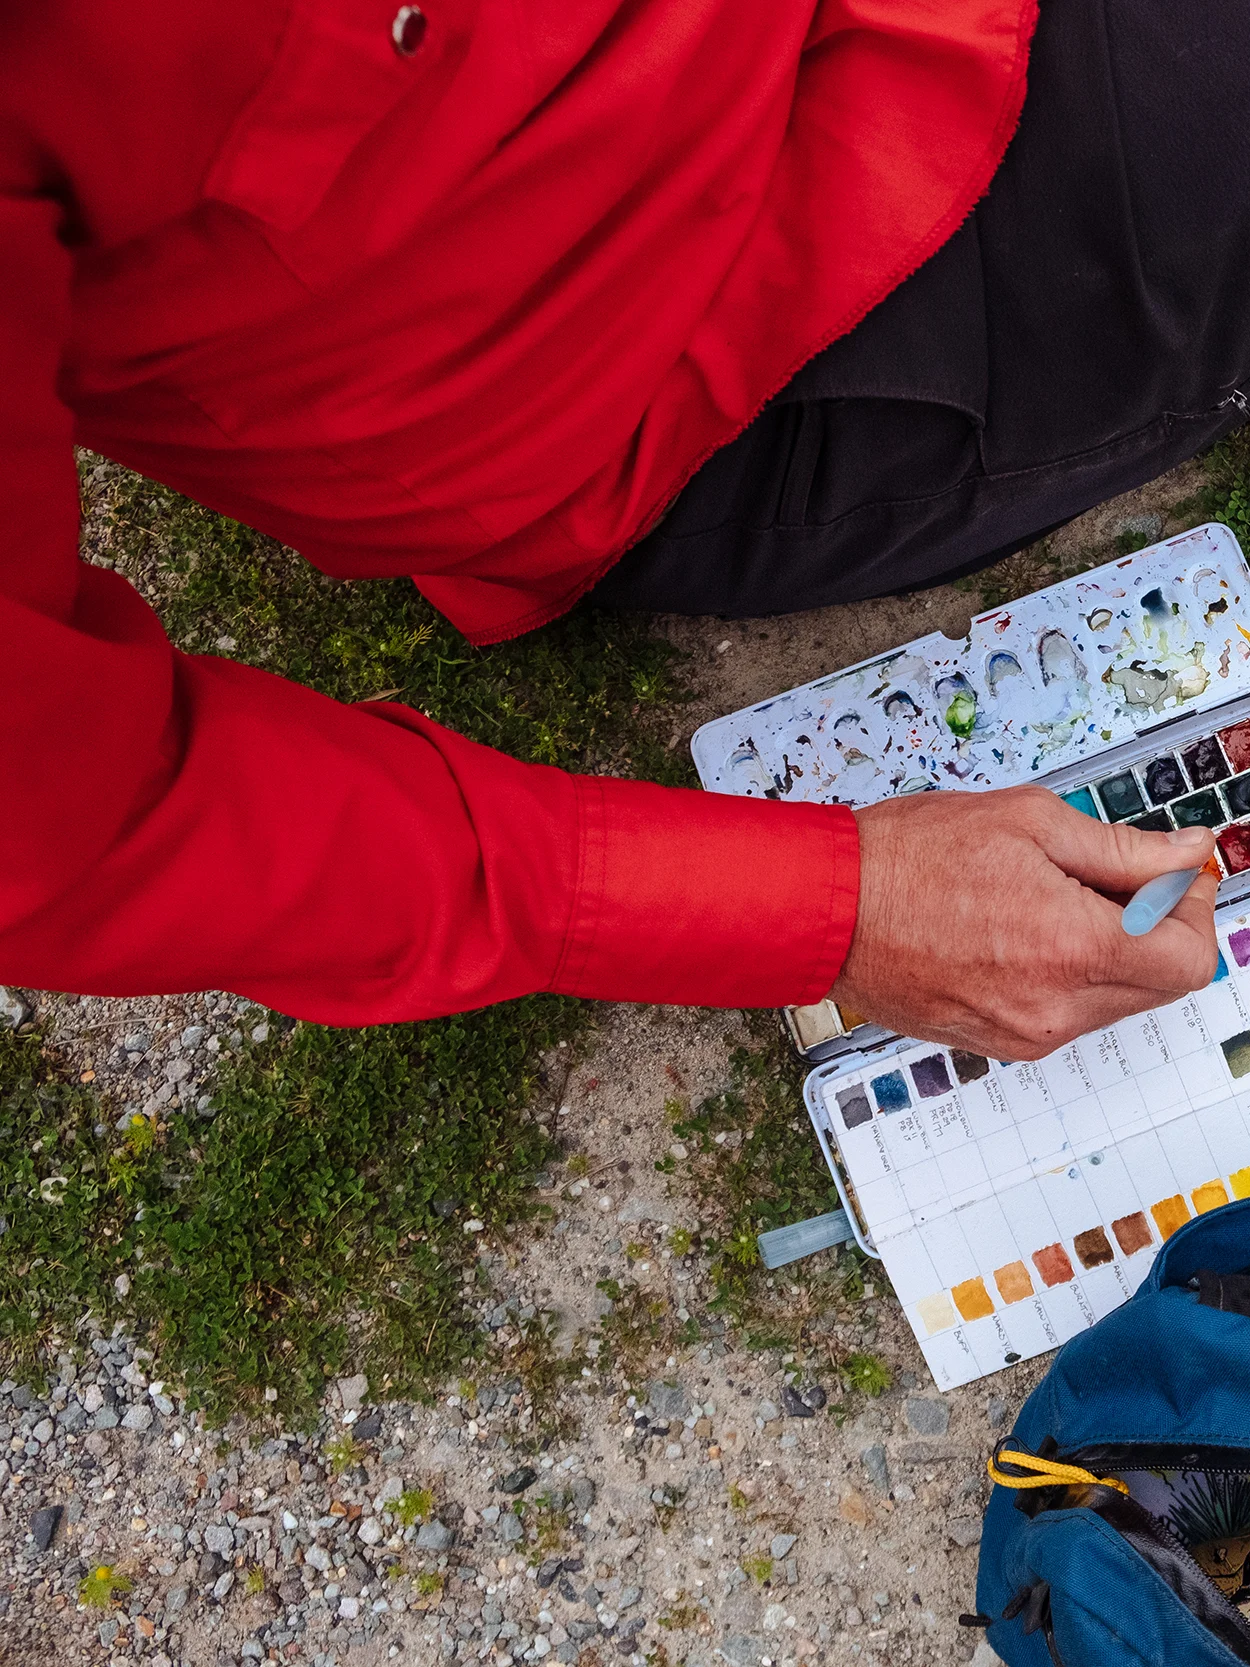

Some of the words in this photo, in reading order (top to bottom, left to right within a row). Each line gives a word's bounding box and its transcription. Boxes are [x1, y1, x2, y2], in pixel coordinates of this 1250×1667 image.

[1100, 1033, 1112, 1050] HUE
[1146, 1012, 1163, 1044] COBALT
[982, 1080, 998, 1112] BROWN
[992, 1316, 1006, 1340] MARS
